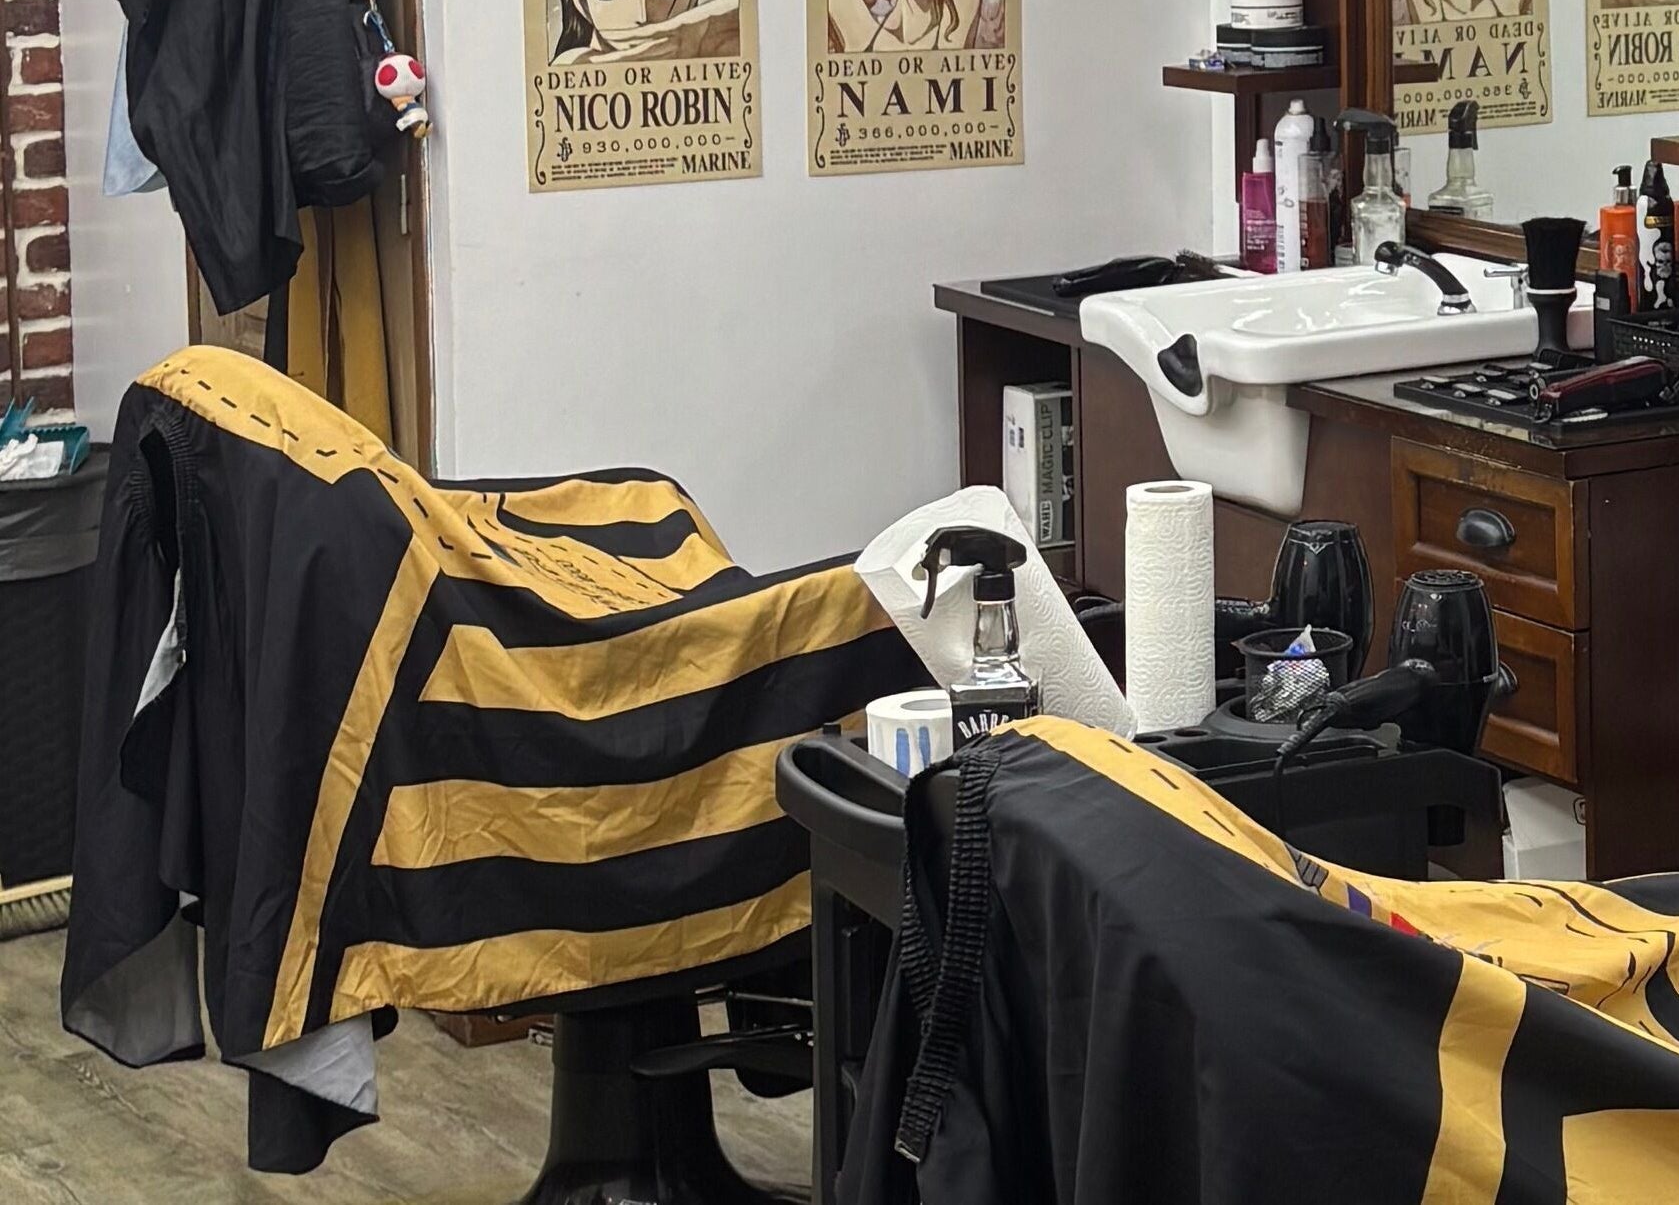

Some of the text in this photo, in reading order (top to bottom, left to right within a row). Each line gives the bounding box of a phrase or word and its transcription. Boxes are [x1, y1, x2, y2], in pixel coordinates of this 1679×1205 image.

[548, 63, 741, 90] DEAD OR ALIVE
[828, 54, 1006, 77] DEAD OR ALIVE
[554, 87, 732, 133] NICO ROBIN
[838, 76, 998, 118] NAMI
[682, 150, 751, 174] MARINE
[950, 139, 1013, 161] MARINE
[1040, 404, 1054, 539] WAHL MAGIC CLIP
